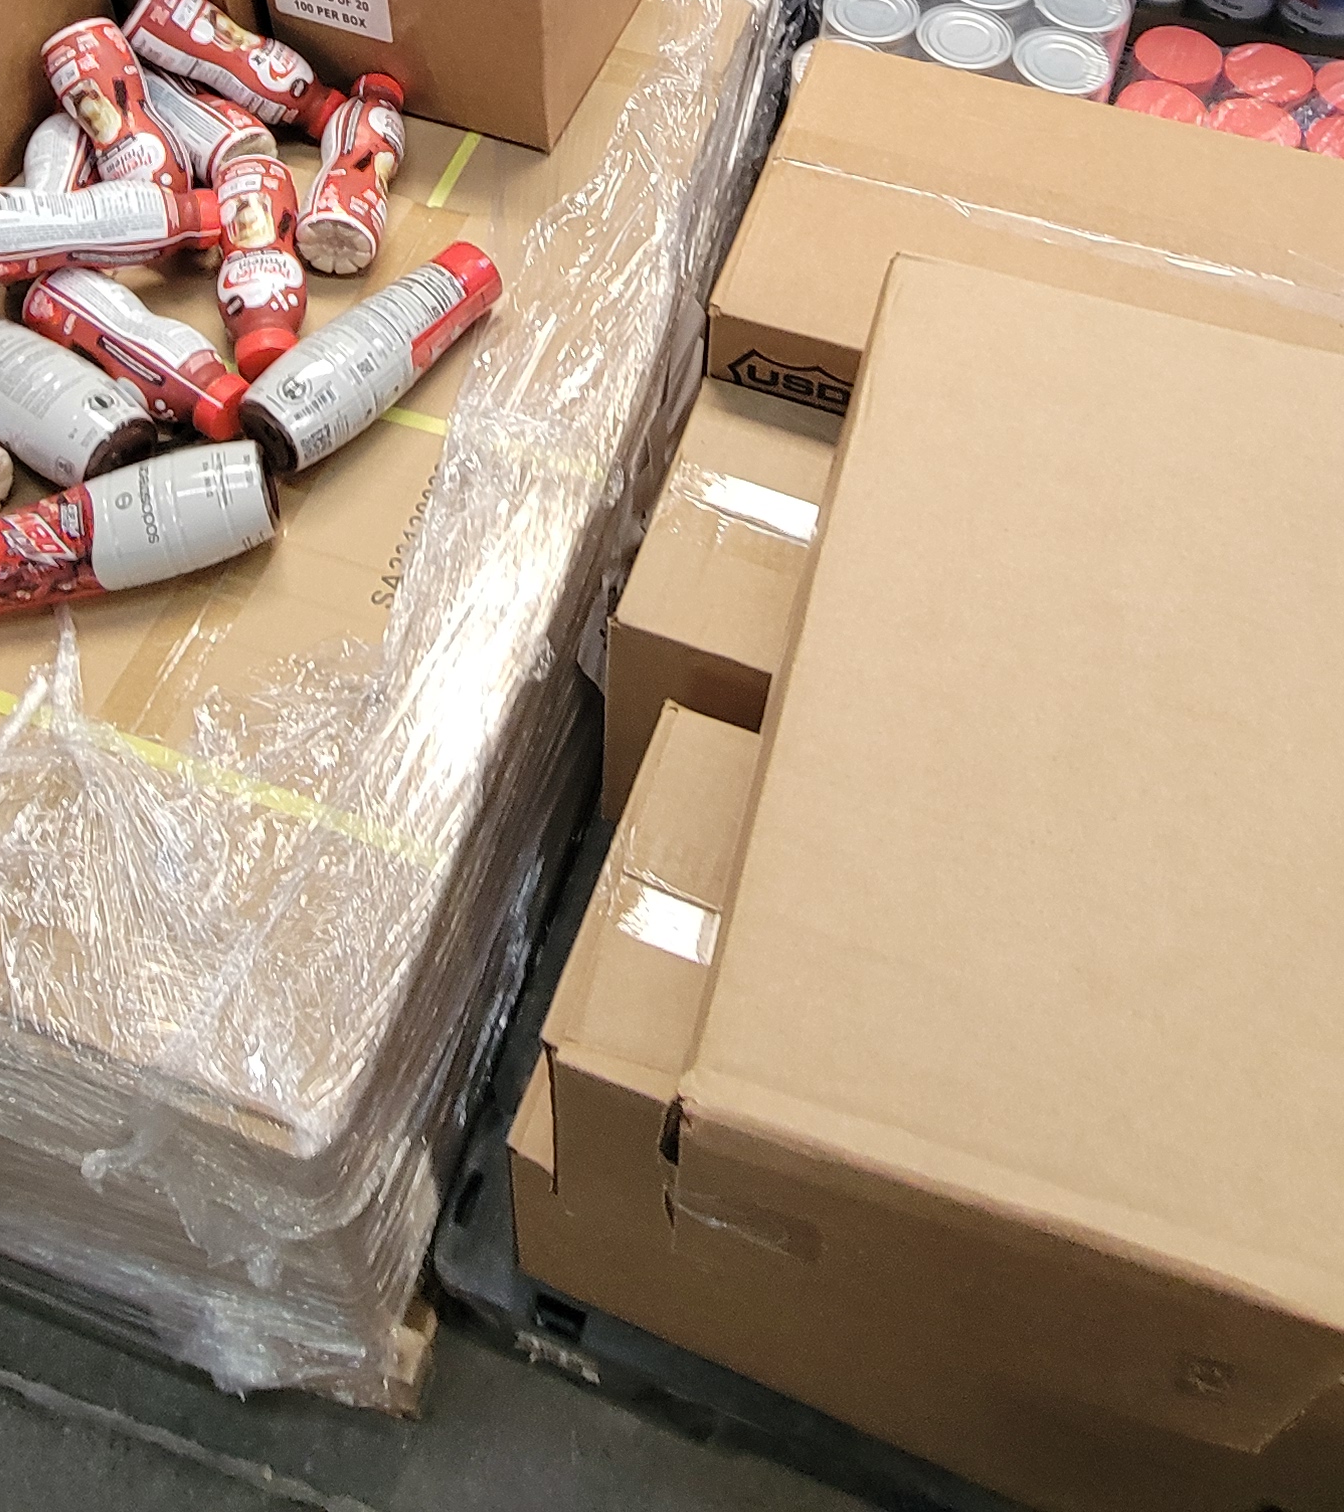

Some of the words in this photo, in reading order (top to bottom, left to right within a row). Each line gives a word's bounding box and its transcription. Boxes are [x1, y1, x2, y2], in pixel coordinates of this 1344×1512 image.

[294, 0, 315, 14] 100
[316, 6, 340, 22] PER
[342, 15, 368, 29] BOX
[355, 0, 370, 13] 20
[746, 363, 851, 406] USD
